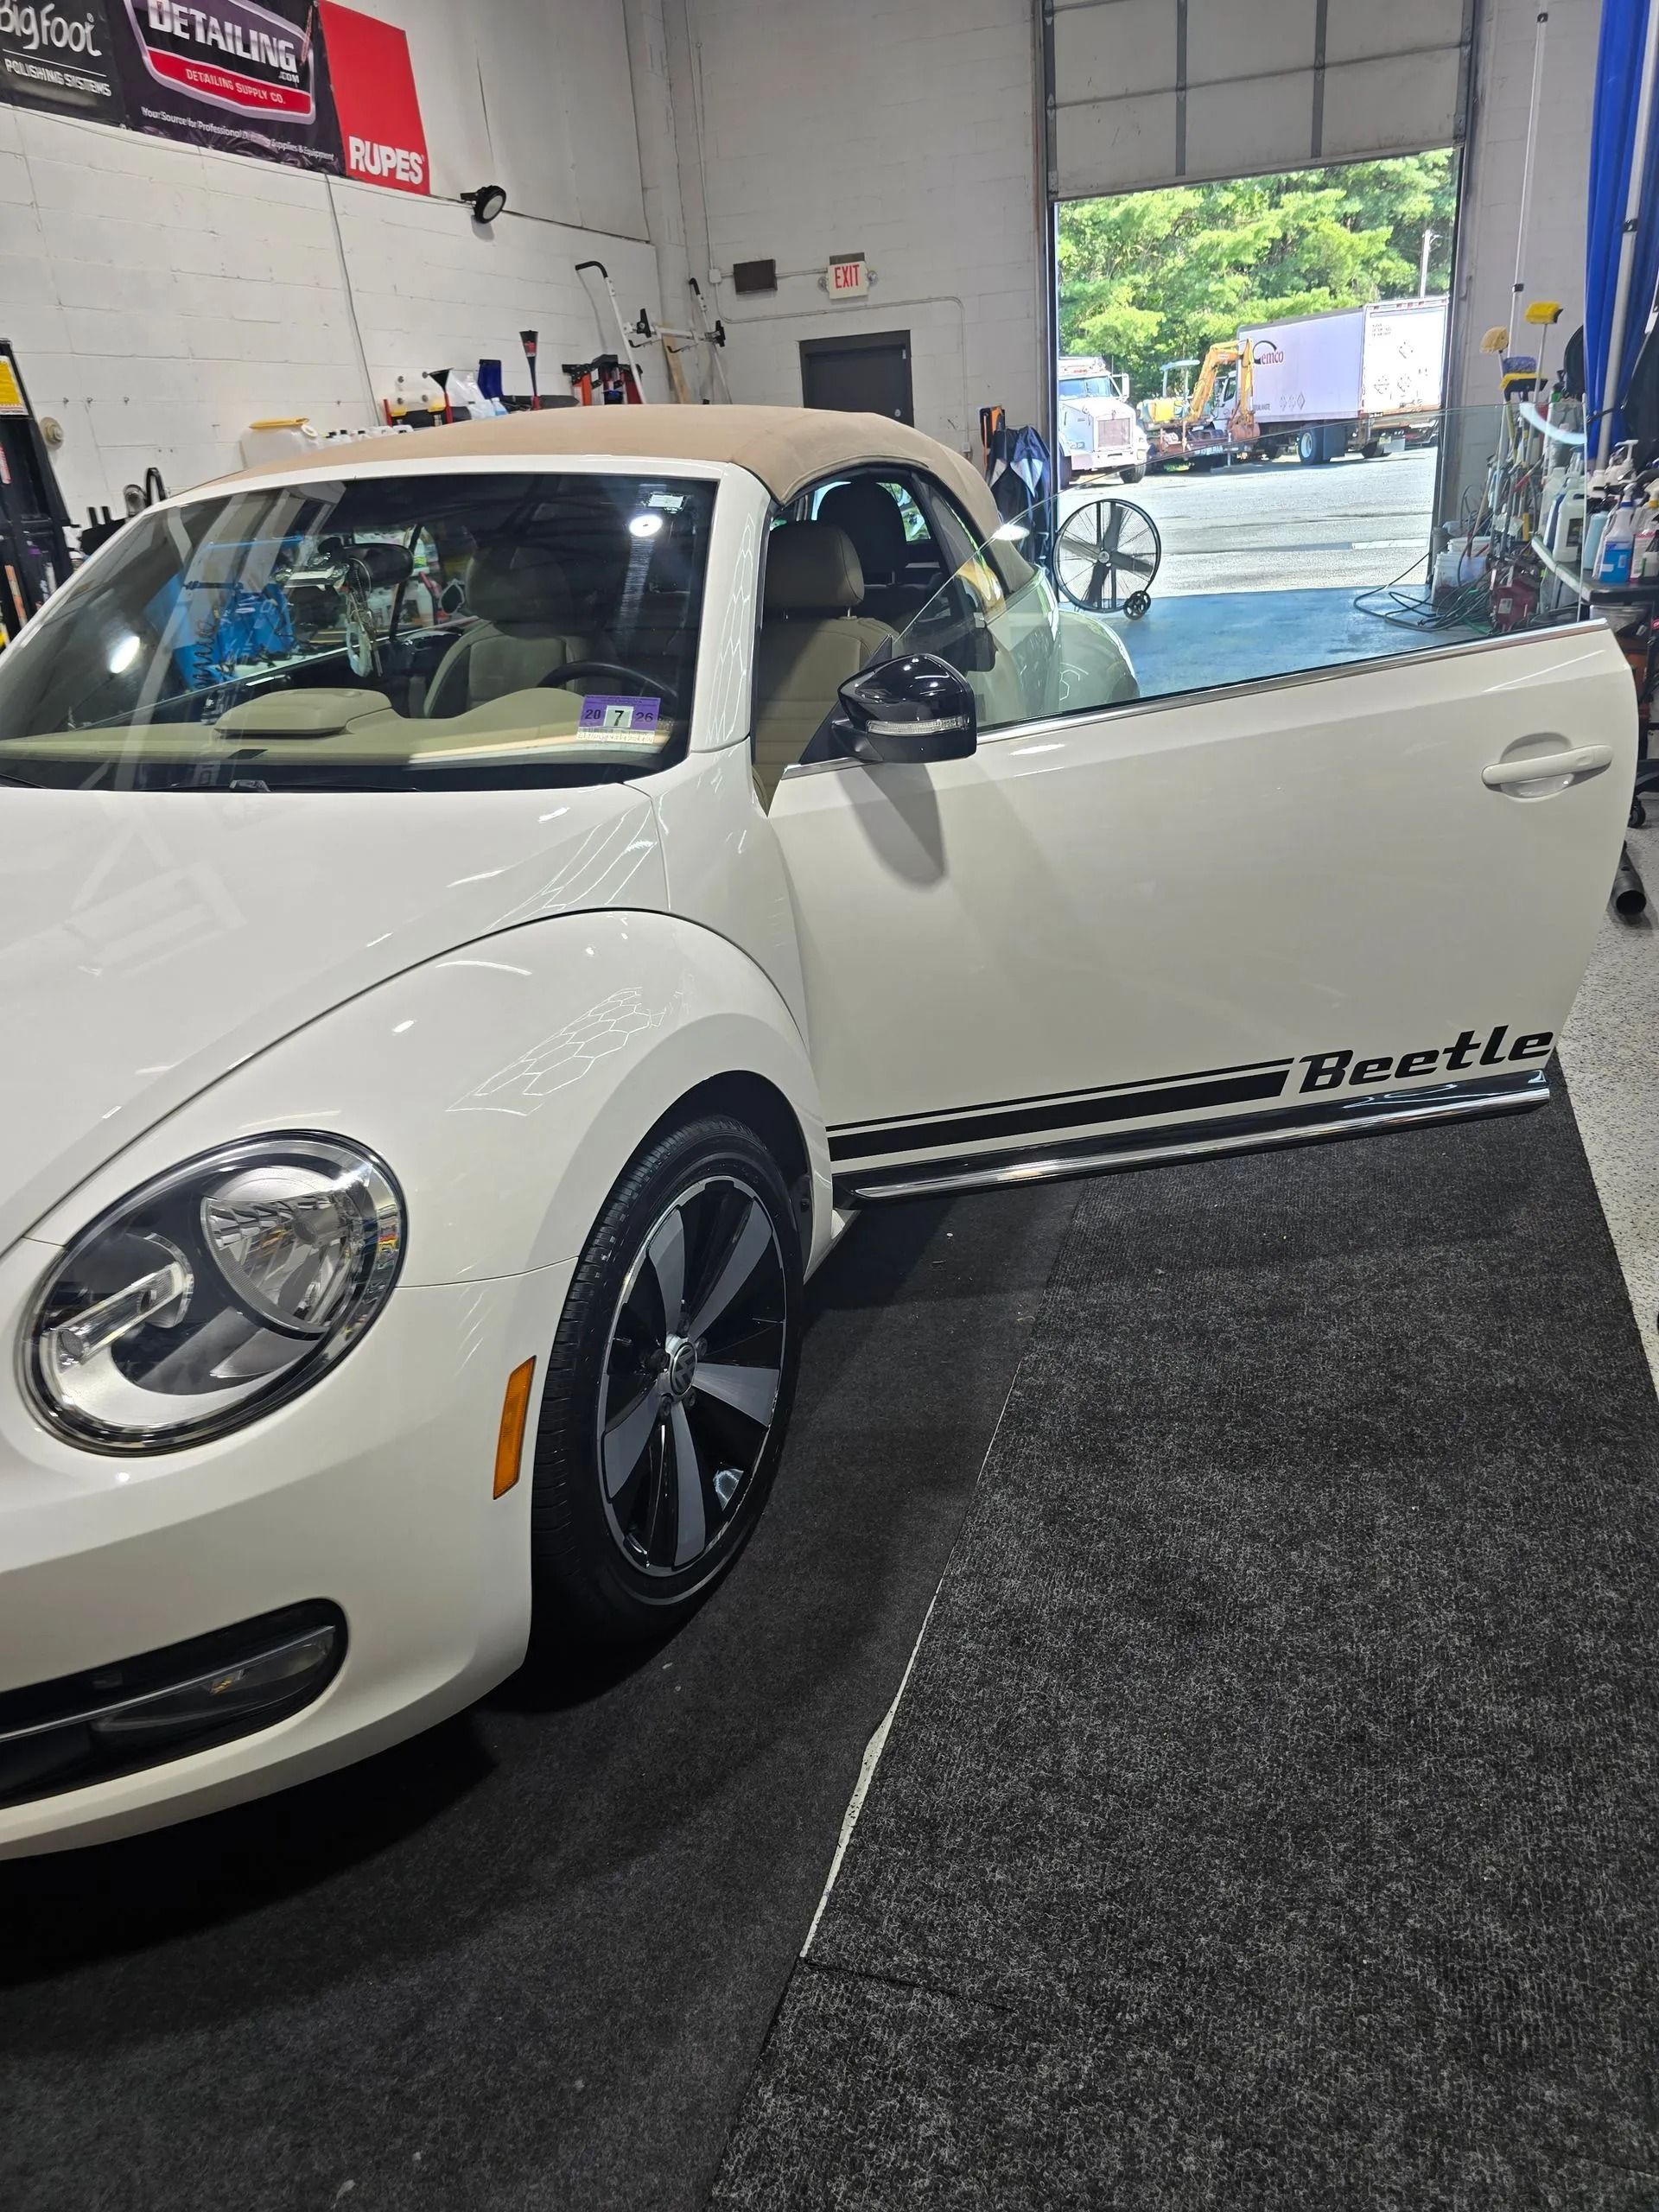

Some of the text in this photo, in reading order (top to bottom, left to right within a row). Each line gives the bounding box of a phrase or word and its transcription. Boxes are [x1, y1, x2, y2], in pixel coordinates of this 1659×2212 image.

[148, 0, 297, 73] DETAILING
[4, 58, 112, 97] POLISHING SYSTEMS
[185, 68, 286, 105] DETAILING SUPPLY CO.
[141, 106, 161, 119] Your
[160, 111, 187, 125] Source
[196, 121, 242, 138] Professional
[348, 135, 423, 185] RUPES
[835, 264, 860, 289] EXIT
[584, 709, 654, 727] 20 7 26
[1299, 1024, 1554, 1094] Beetle
